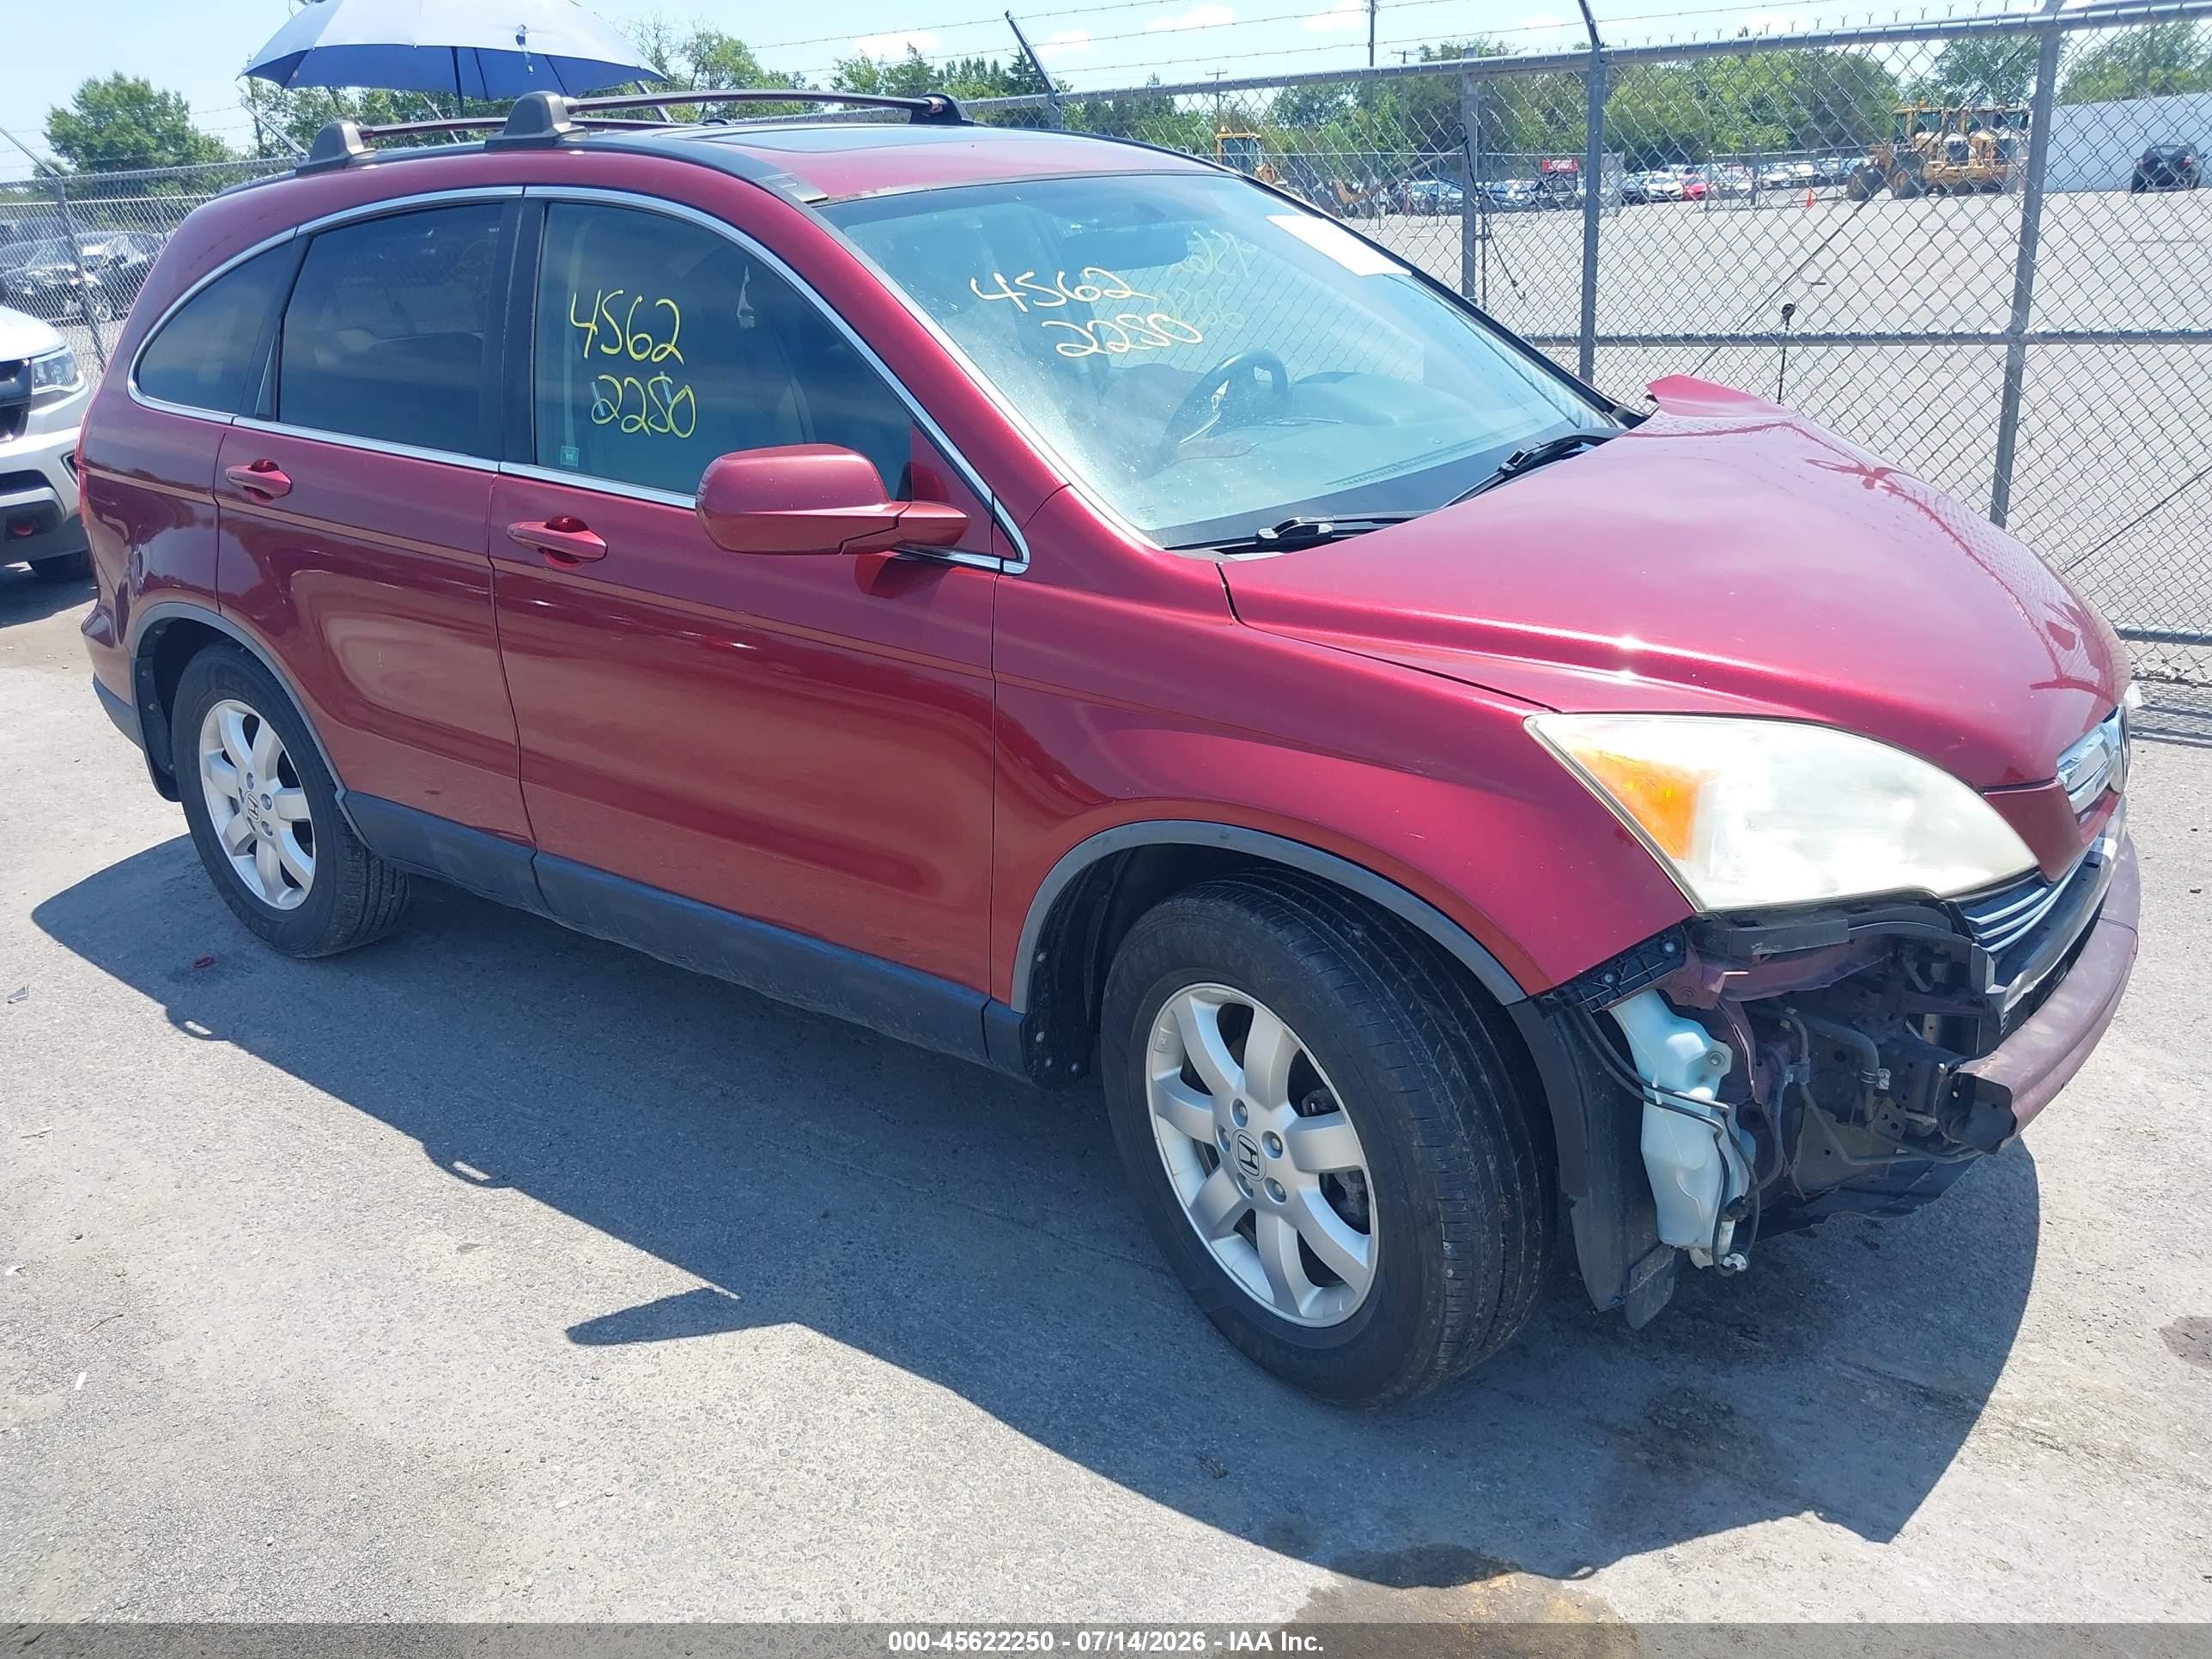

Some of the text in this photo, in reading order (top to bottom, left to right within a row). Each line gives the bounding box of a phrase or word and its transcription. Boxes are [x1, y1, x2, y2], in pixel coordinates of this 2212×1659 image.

[969, 267, 1158, 313] 4562
[570, 289, 684, 365] 4562
[1042, 313, 1203, 357] 2250
[591, 374, 696, 439] 2250
